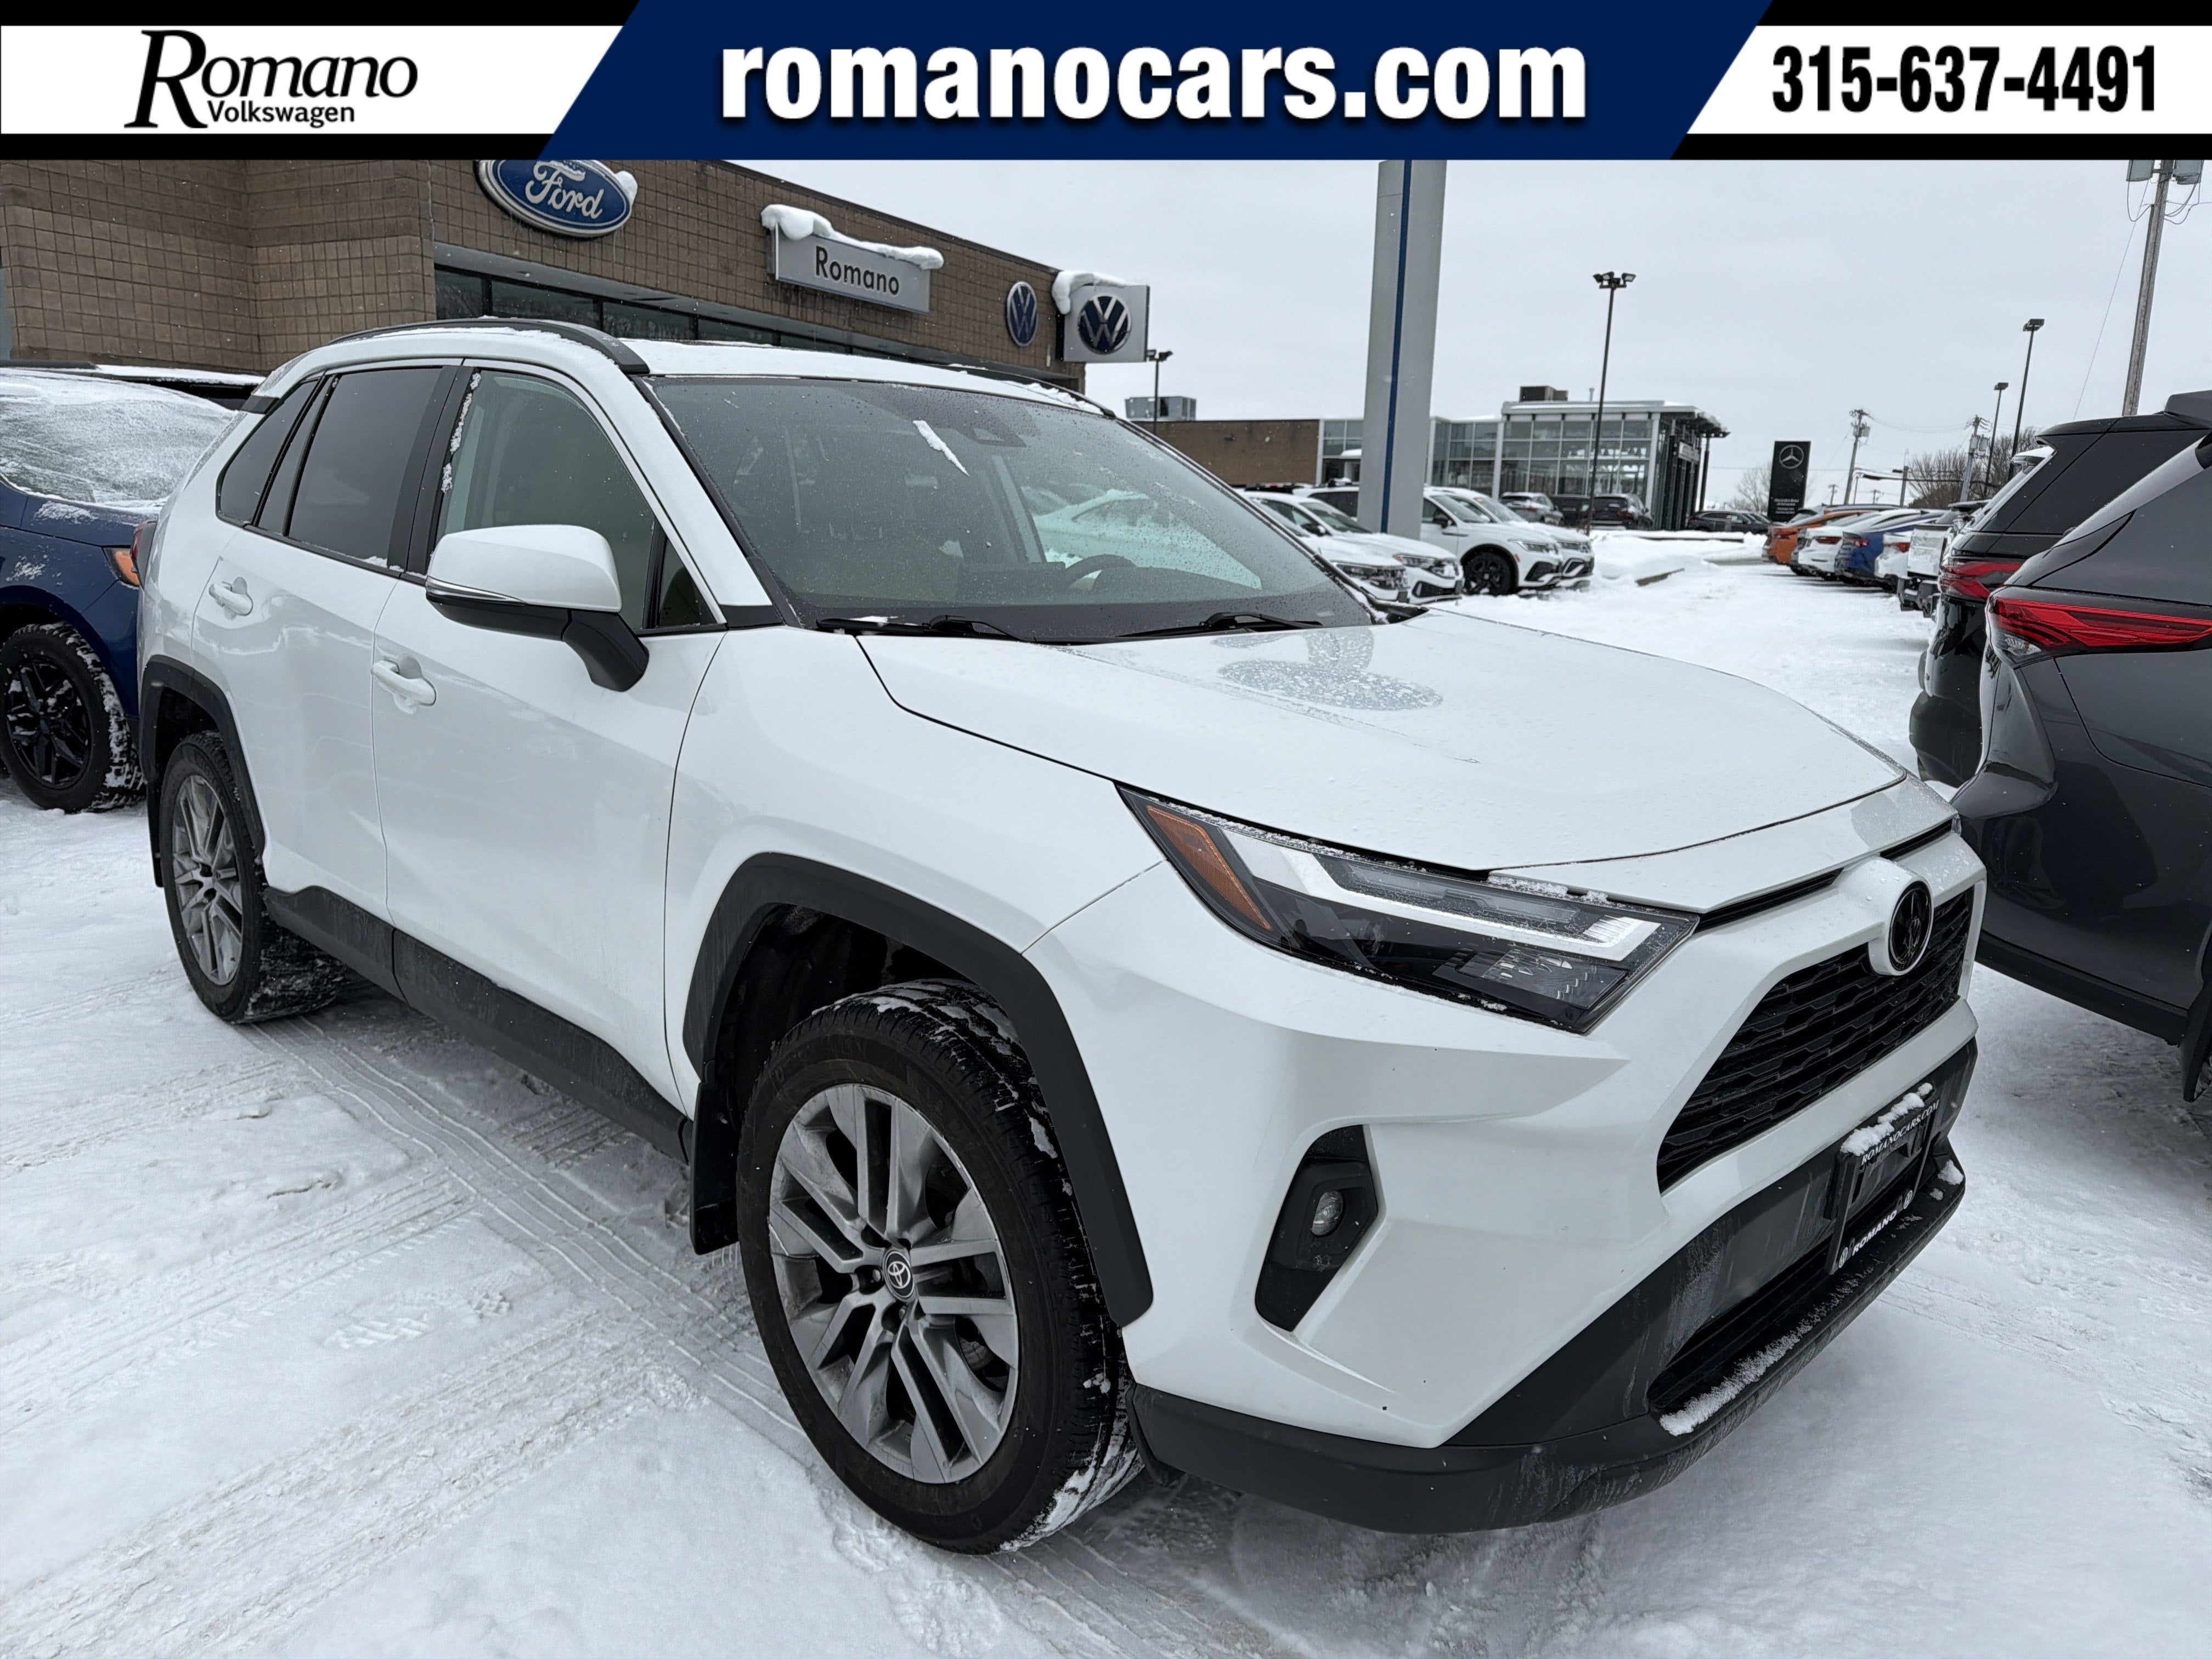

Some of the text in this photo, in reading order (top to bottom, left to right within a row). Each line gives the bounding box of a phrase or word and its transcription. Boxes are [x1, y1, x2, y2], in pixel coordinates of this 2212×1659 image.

[525, 161, 604, 219] Ford
[816, 245, 899, 295] Romano
[1852, 1210, 1898, 1256] ROMANO
